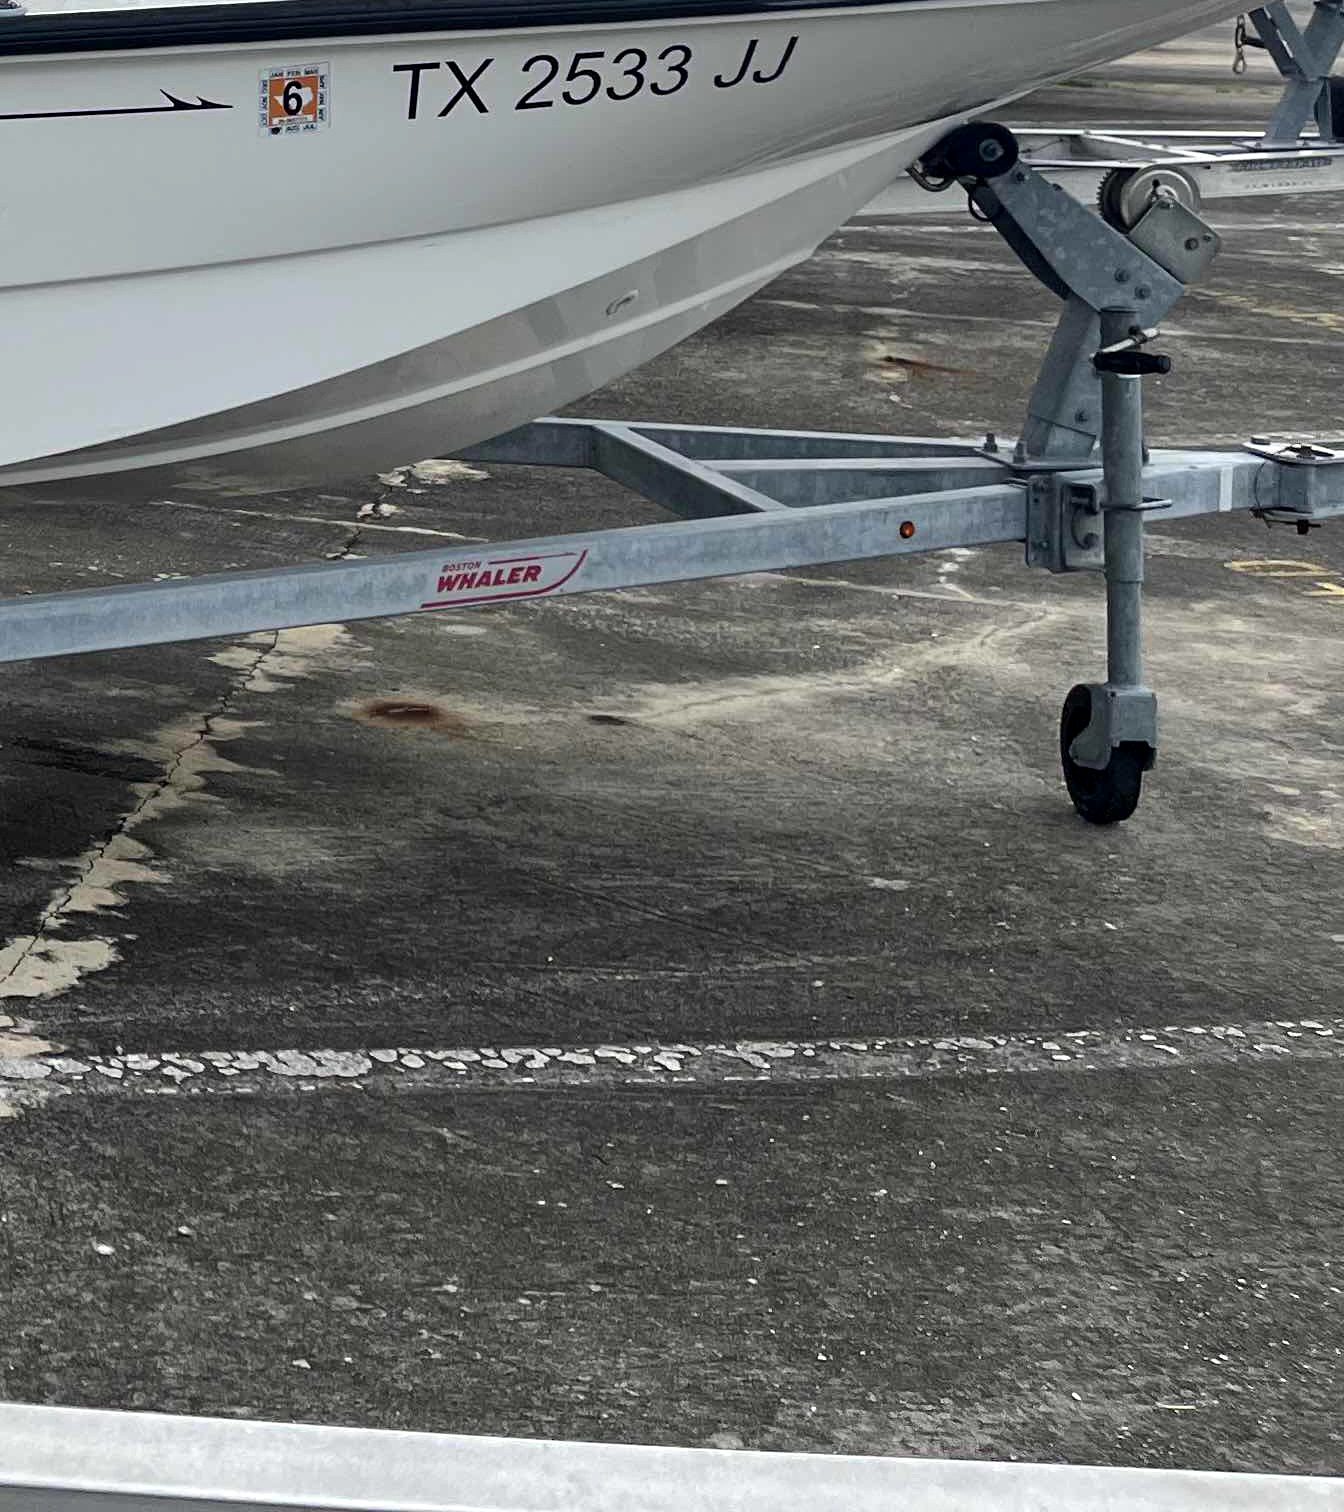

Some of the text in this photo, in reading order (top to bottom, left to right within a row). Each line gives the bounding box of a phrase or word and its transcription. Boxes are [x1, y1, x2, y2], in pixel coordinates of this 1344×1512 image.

[392, 35, 800, 120] TX 2533 JJ
[282, 80, 303, 116] 6
[436, 564, 542, 593] WHALER
[441, 560, 482, 573] BOSTON
